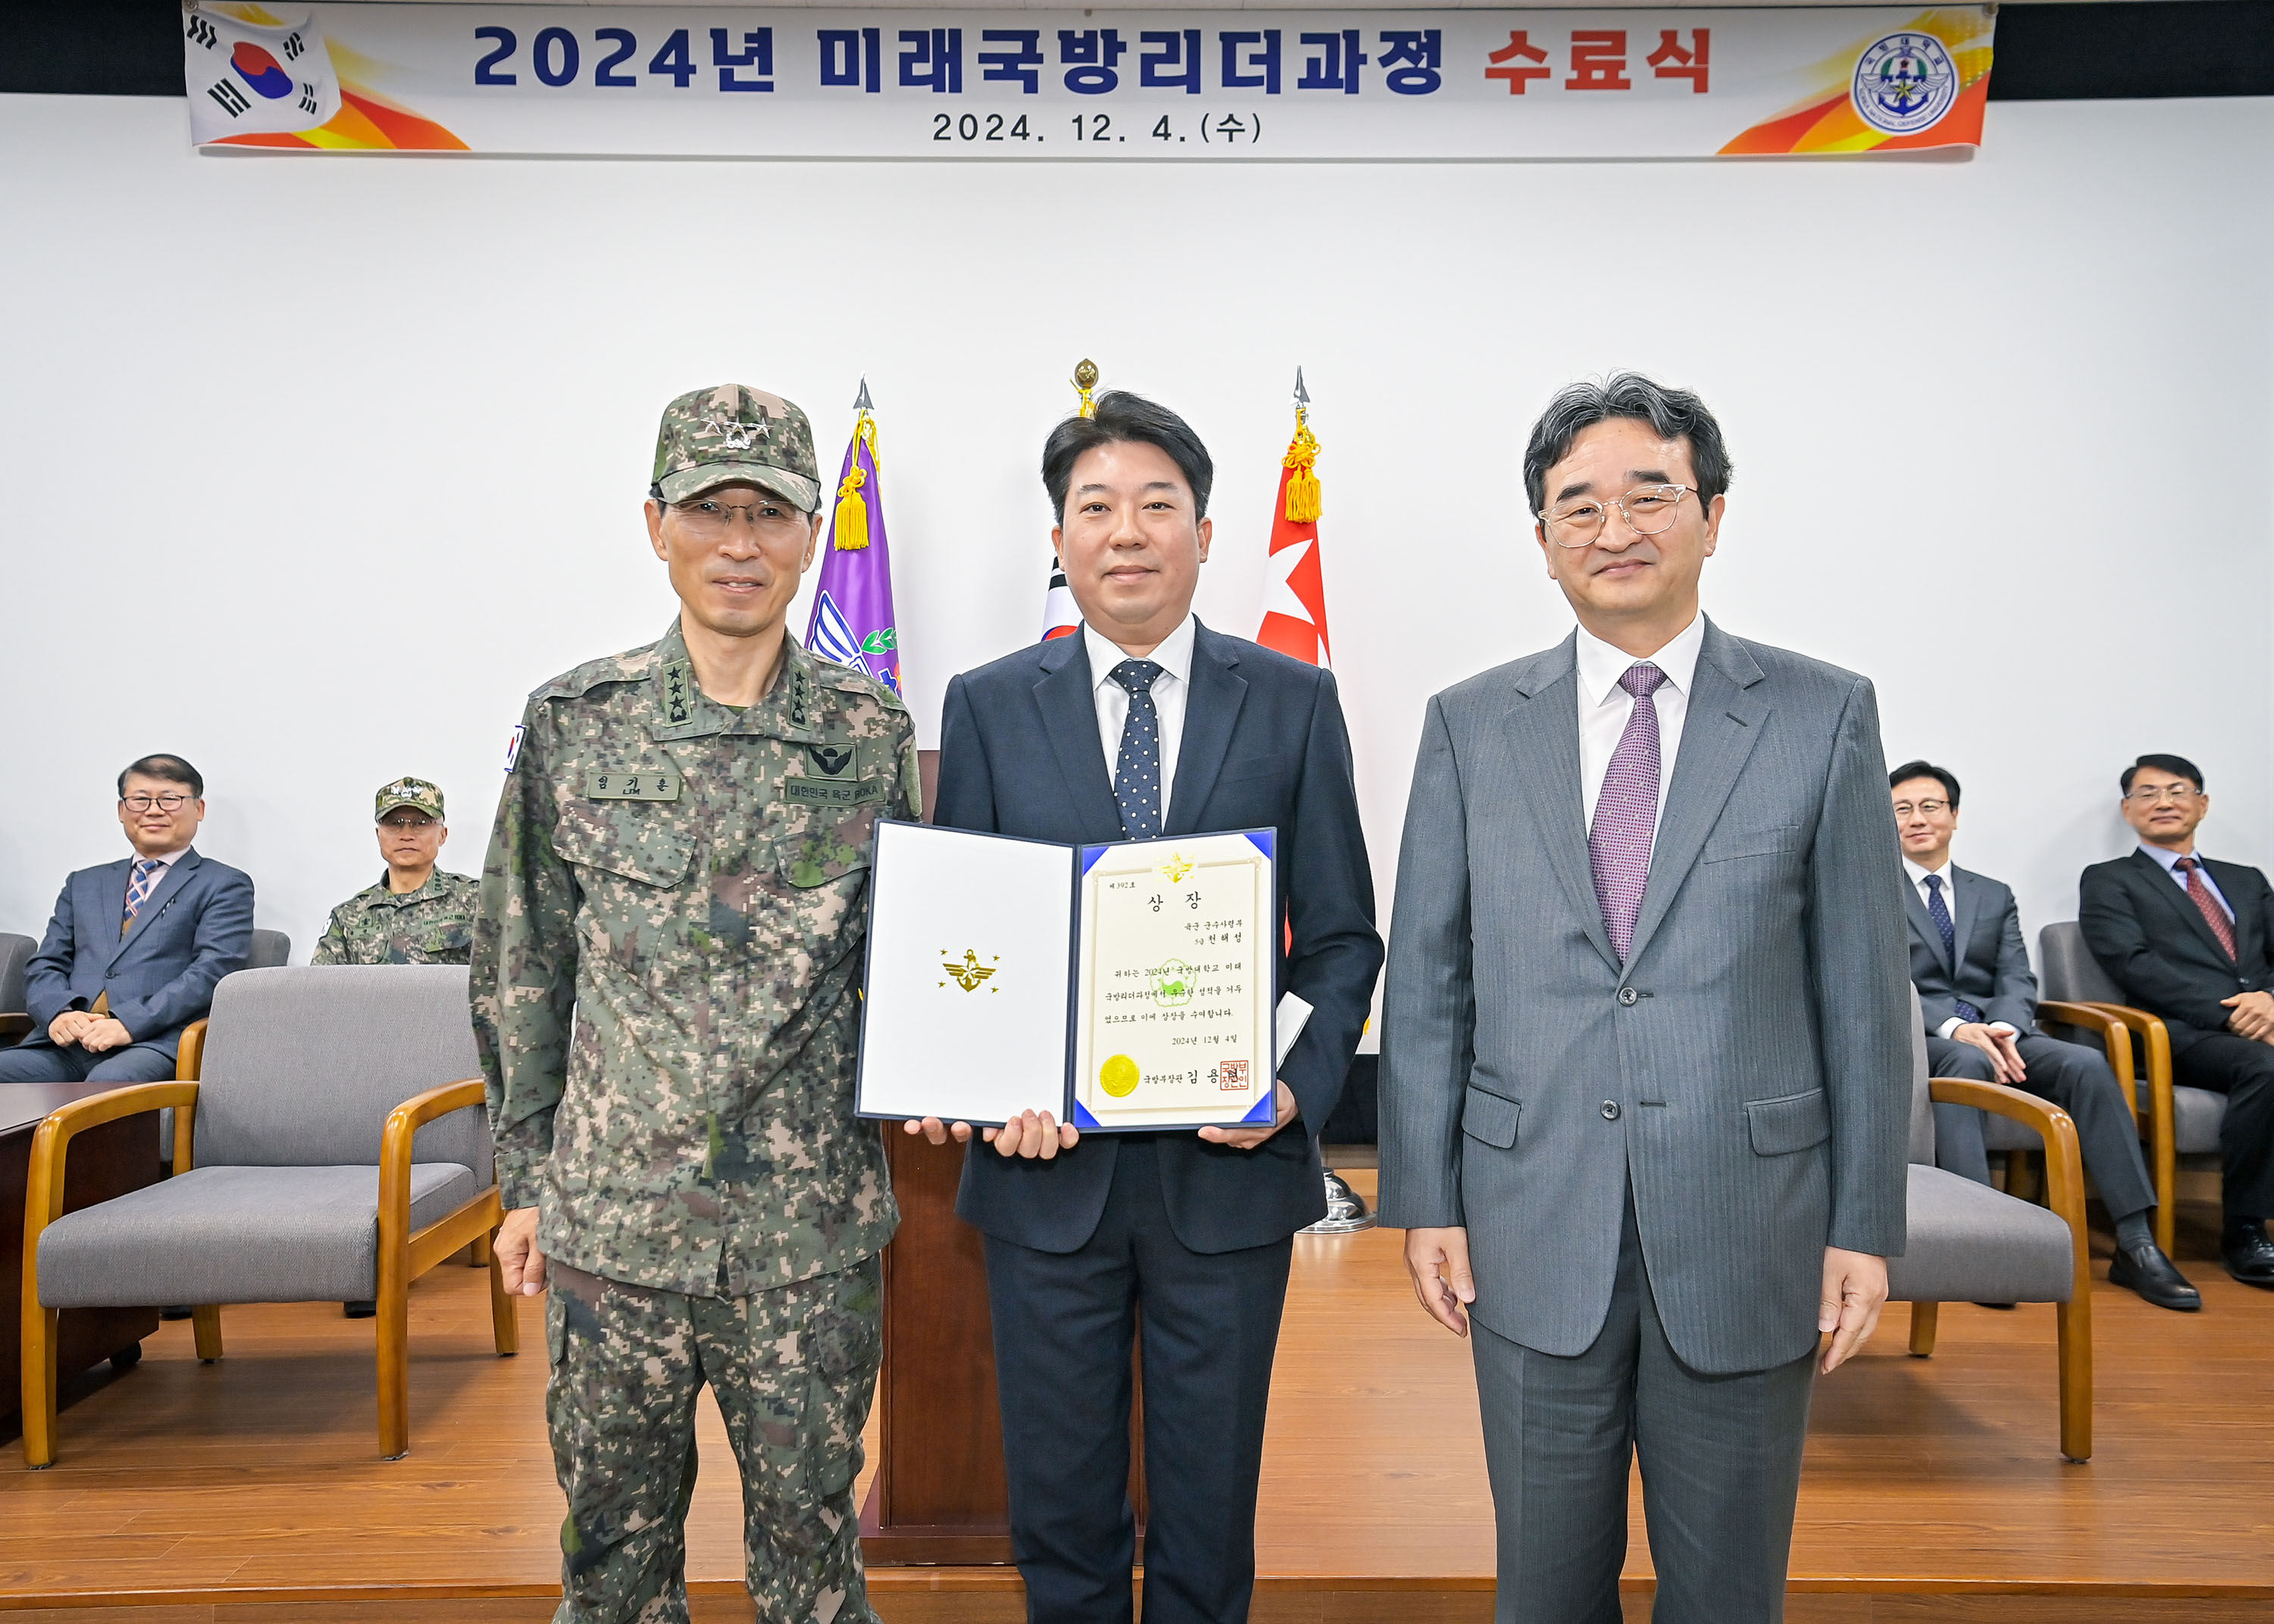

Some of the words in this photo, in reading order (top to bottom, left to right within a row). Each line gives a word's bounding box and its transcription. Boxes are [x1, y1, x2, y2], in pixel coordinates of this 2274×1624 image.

[474, 27, 774, 92] 2024년
[816, 27, 1442, 95] 미래국방리더과정
[1485, 28, 1710, 95] 수료식
[933, 114, 1045, 142] 2024.
[1072, 114, 1126, 142] 12.
[791, 785, 828, 799] 대한민국
[832, 789, 850, 800] 육군
[854, 785, 879, 799] ROKA
[1145, 967, 1170, 976] 2024년
[1226, 962, 1242, 971] 미래
[1172, 1036, 1198, 1045] 2024년
[1225, 1034, 1237, 1044] 4일
